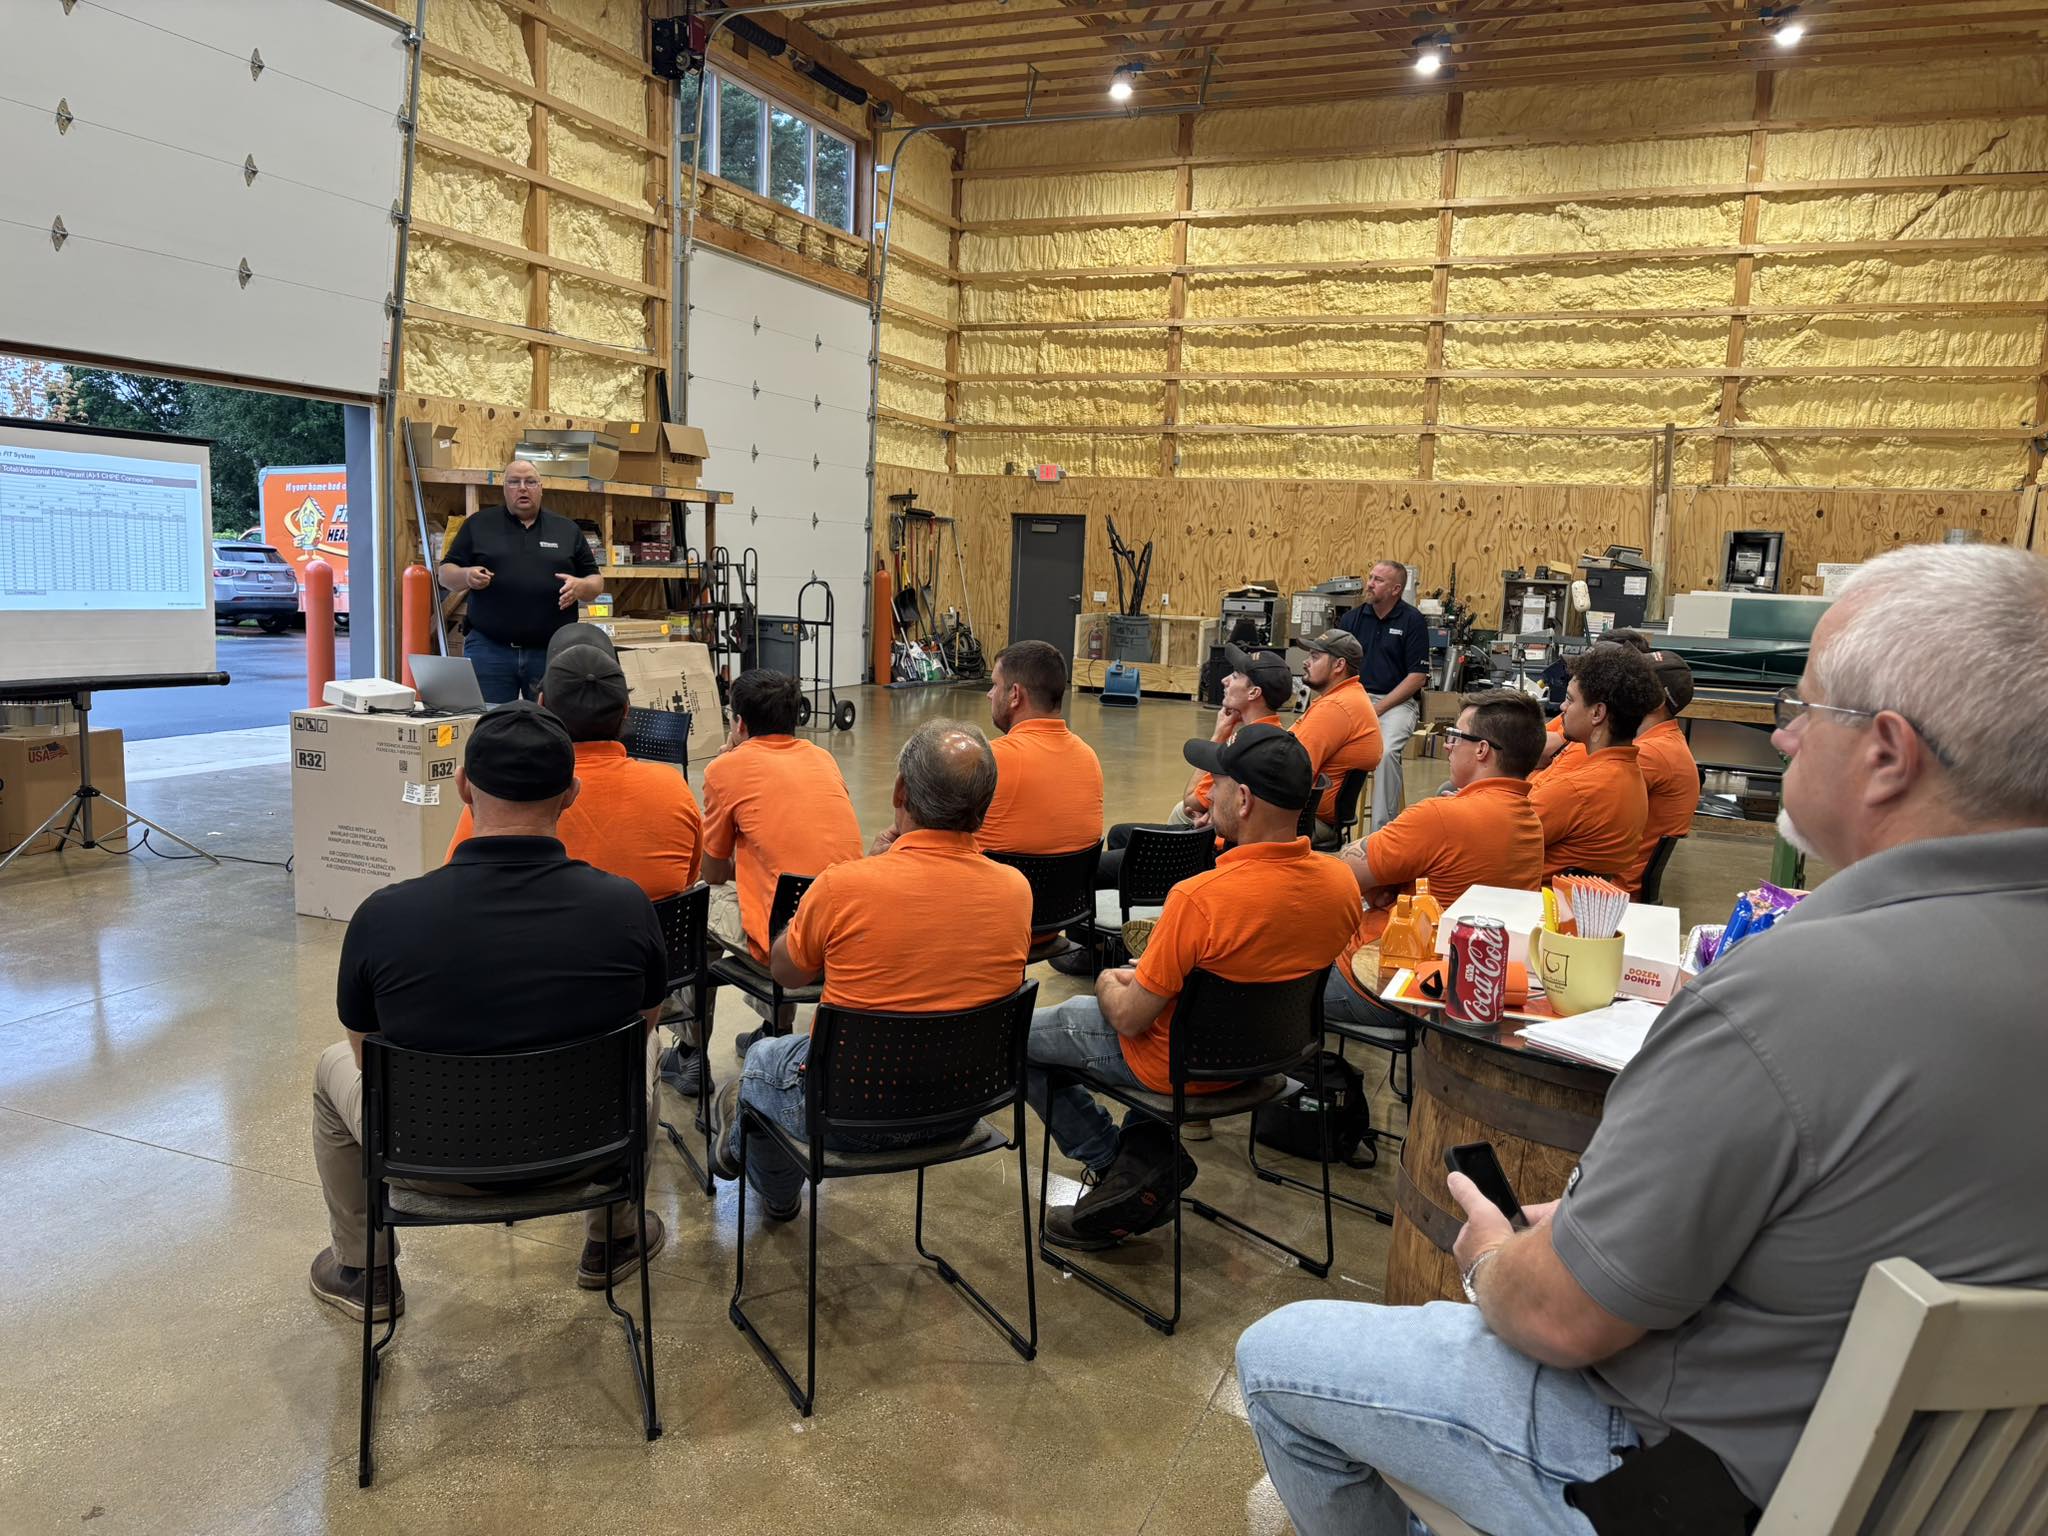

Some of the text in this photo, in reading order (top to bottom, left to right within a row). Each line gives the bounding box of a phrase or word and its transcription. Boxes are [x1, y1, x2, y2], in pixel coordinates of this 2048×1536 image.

[13, 452, 36, 461] System
[51, 468, 85, 480] Refrigerant
[121, 474, 154, 484] Connection
[1040, 465, 1057, 480] EXIT
[292, 483, 308, 493] your
[308, 482, 327, 491] home
[328, 481, 341, 491] had
[680, 669, 690, 698] METAL
[28, 750, 50, 764] USA
[299, 752, 322, 768] R32
[431, 761, 453, 779] R32
[1629, 967, 1660, 980] DOZEN
[1624, 974, 1662, 988] DONUTS
